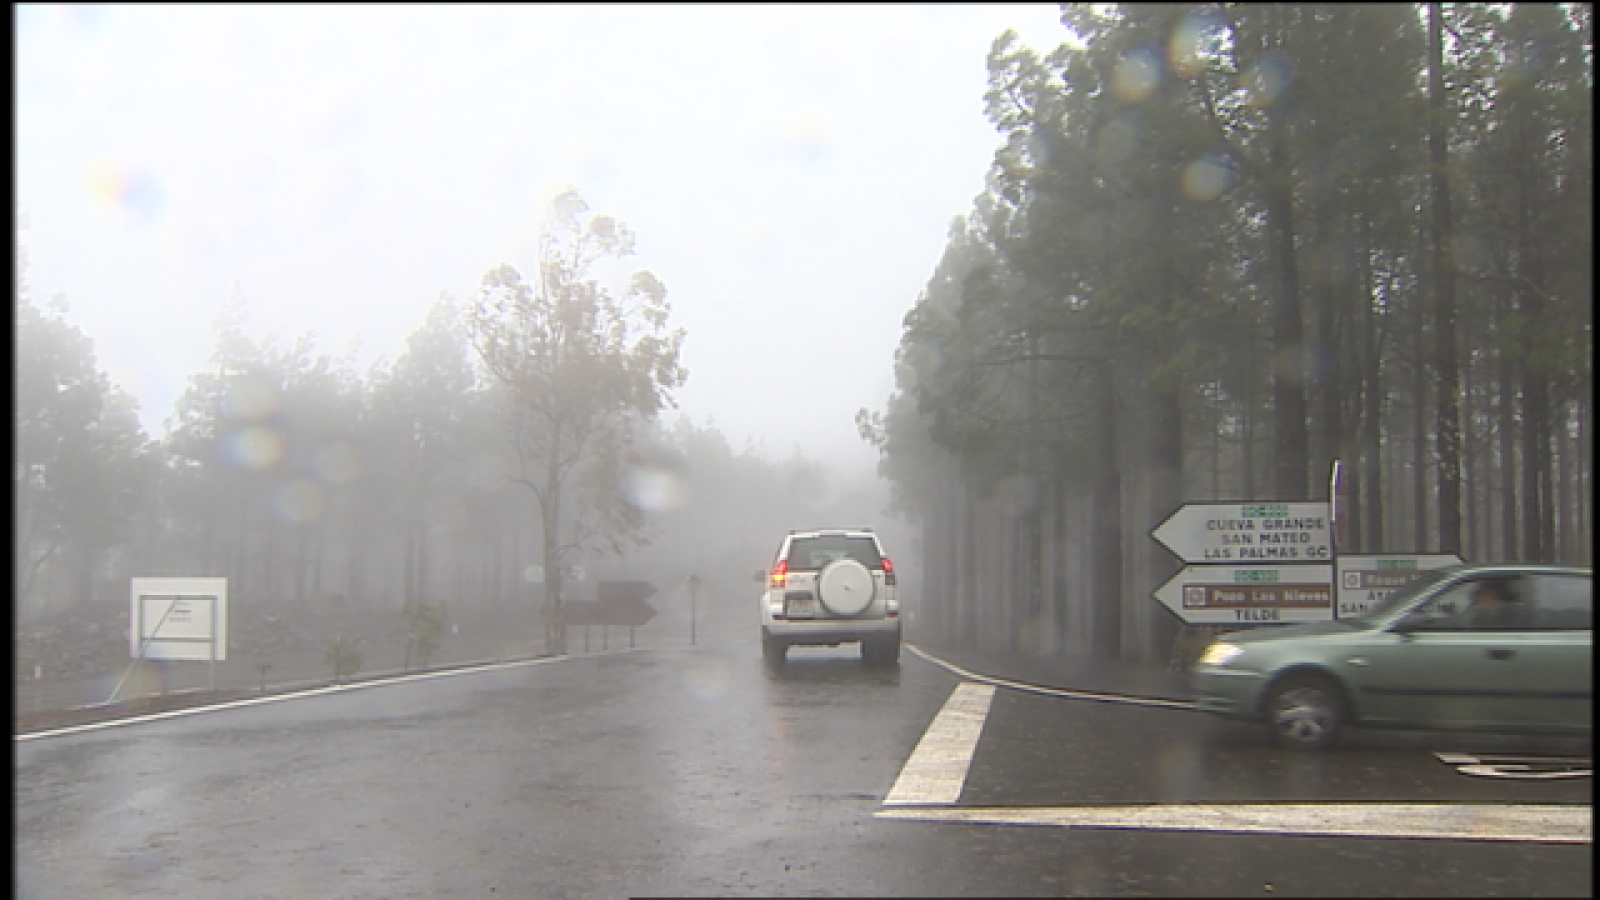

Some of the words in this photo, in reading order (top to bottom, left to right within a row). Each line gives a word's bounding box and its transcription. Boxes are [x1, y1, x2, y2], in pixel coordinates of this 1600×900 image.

[1206, 519, 1255, 530] CUEVA
[1262, 518, 1325, 530] GRANDE
[1221, 533, 1253, 545] SAN
[1259, 532, 1310, 544] MATEO
[1204, 547, 1231, 558] LAS
[1239, 547, 1298, 558] PALMAS
[1283, 589, 1329, 601] Nieves
[1235, 609, 1280, 621] TELDE
